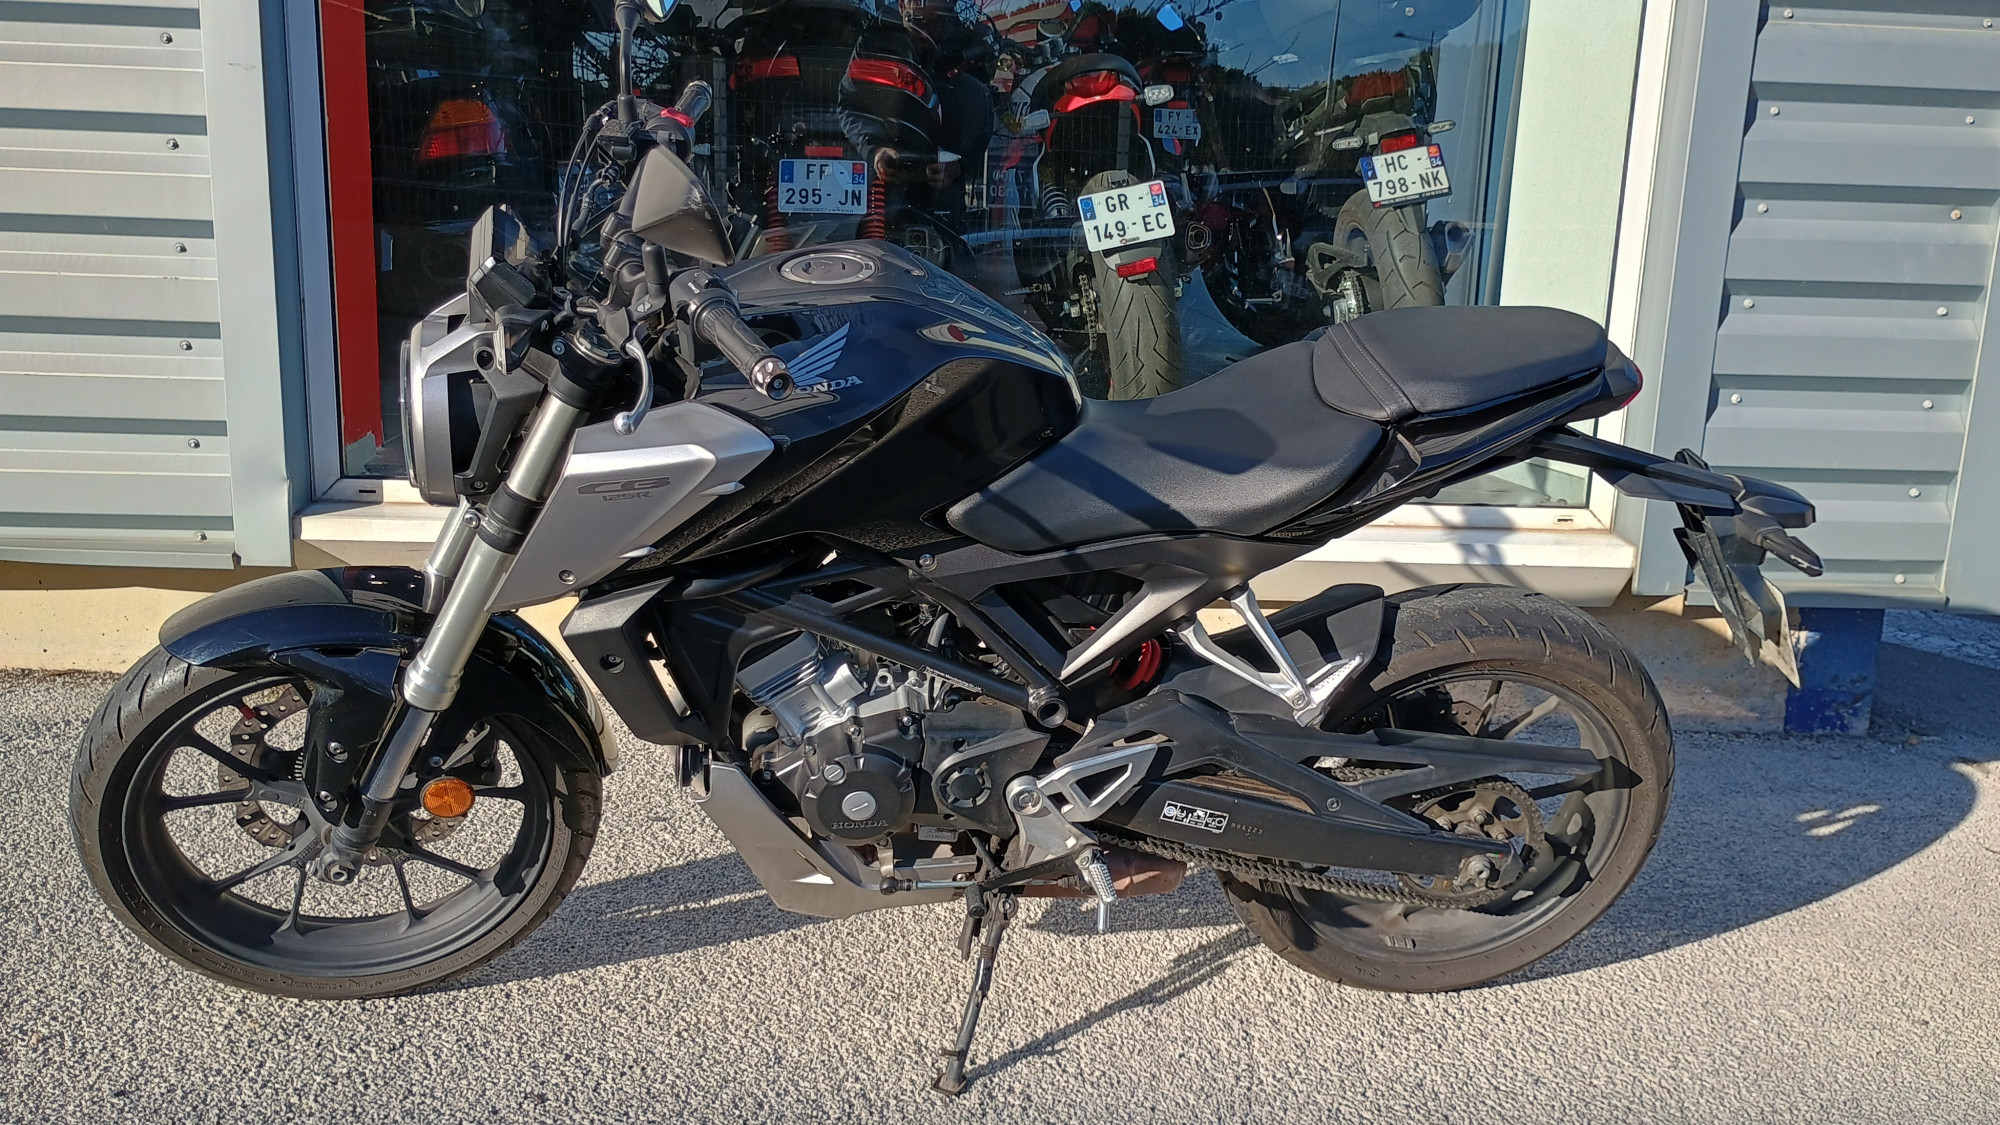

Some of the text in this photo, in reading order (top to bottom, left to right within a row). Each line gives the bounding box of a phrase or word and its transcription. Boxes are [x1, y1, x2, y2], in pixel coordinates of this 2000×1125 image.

[1168, 111, 1181, 121] FY
[1384, 154, 1409, 173] HC
[1430, 157, 1442, 167] 34
[806, 163, 830, 180] FF
[853, 173, 864, 184] 34
[1105, 193, 1130, 213] GR
[1152, 195, 1164, 206] 34
[793, 375, 864, 395] ONDA
[602, 491, 651, 501] 125R
[830, 819, 889, 829] HONDA
